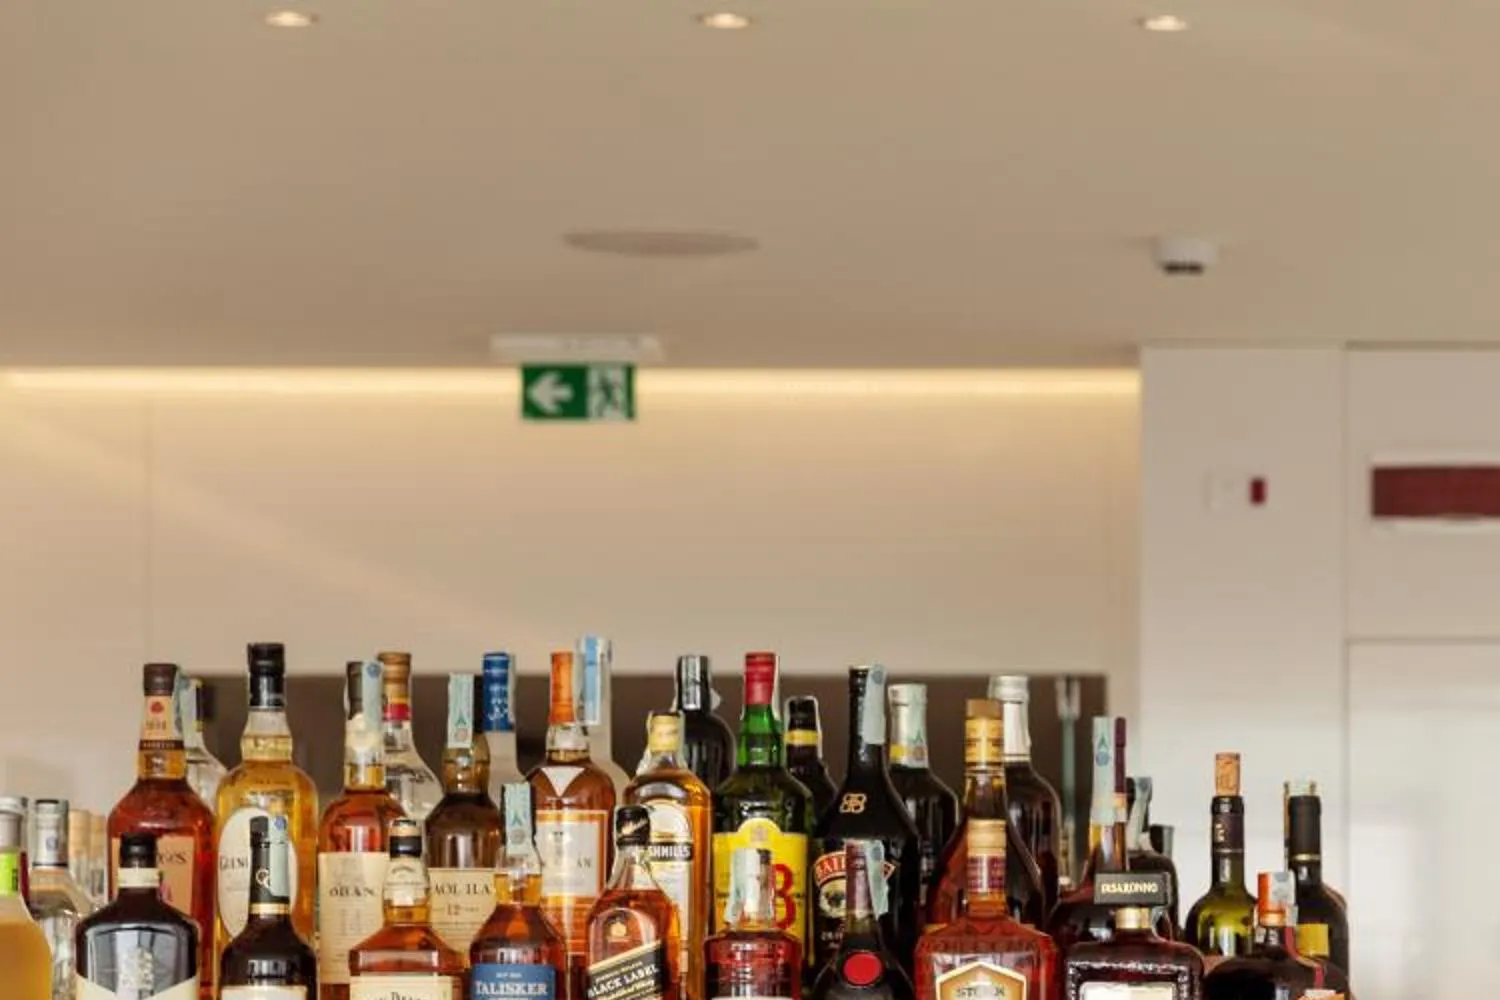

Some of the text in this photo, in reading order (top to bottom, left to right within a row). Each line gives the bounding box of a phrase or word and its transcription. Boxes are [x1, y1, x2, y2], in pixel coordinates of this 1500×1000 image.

[649, 845, 691, 857] SHMILLS
[329, 885, 374, 898] OBAN
[432, 882, 458, 895] AOL
[1100, 882, 1159, 893] DISARONNO
[588, 976, 623, 999] BLACK
[622, 963, 660, 985] LABEL
[474, 981, 549, 996] TALISKER
[956, 986, 1006, 997] STK
